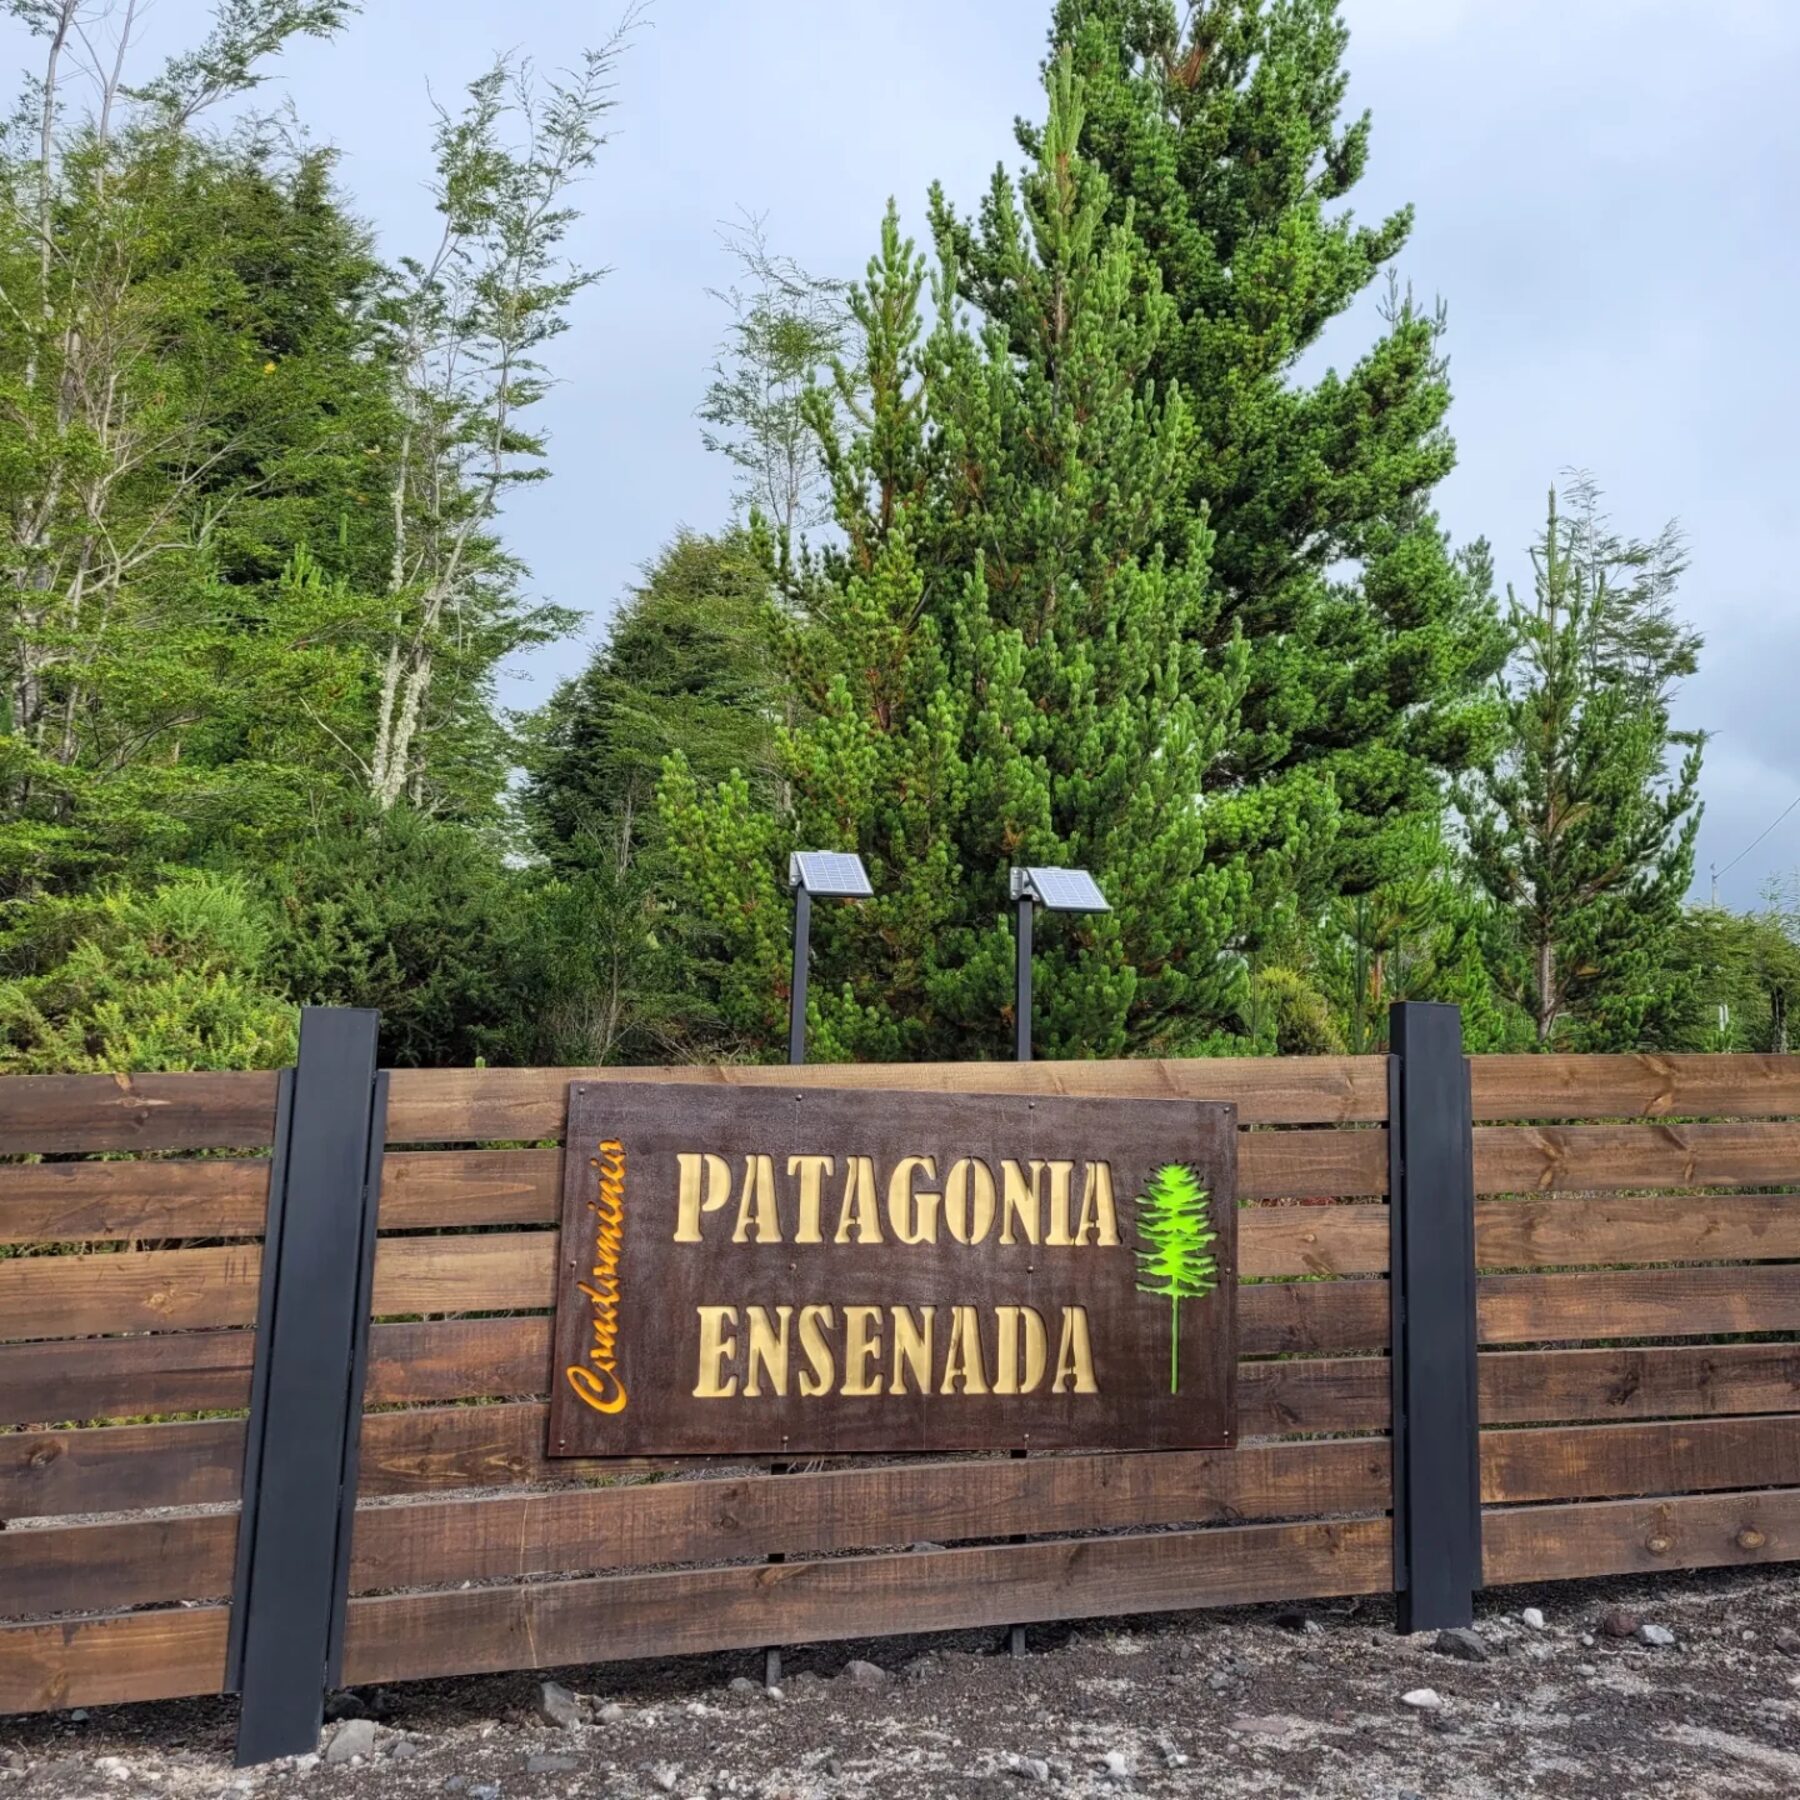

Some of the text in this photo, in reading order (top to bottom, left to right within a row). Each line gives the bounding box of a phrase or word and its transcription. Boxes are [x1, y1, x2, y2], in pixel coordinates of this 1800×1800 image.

[673, 1152, 1121, 1247] PATAGONIA
[566, 1138, 628, 1414] Condominio
[692, 1303, 1100, 1397] ENSENADA
